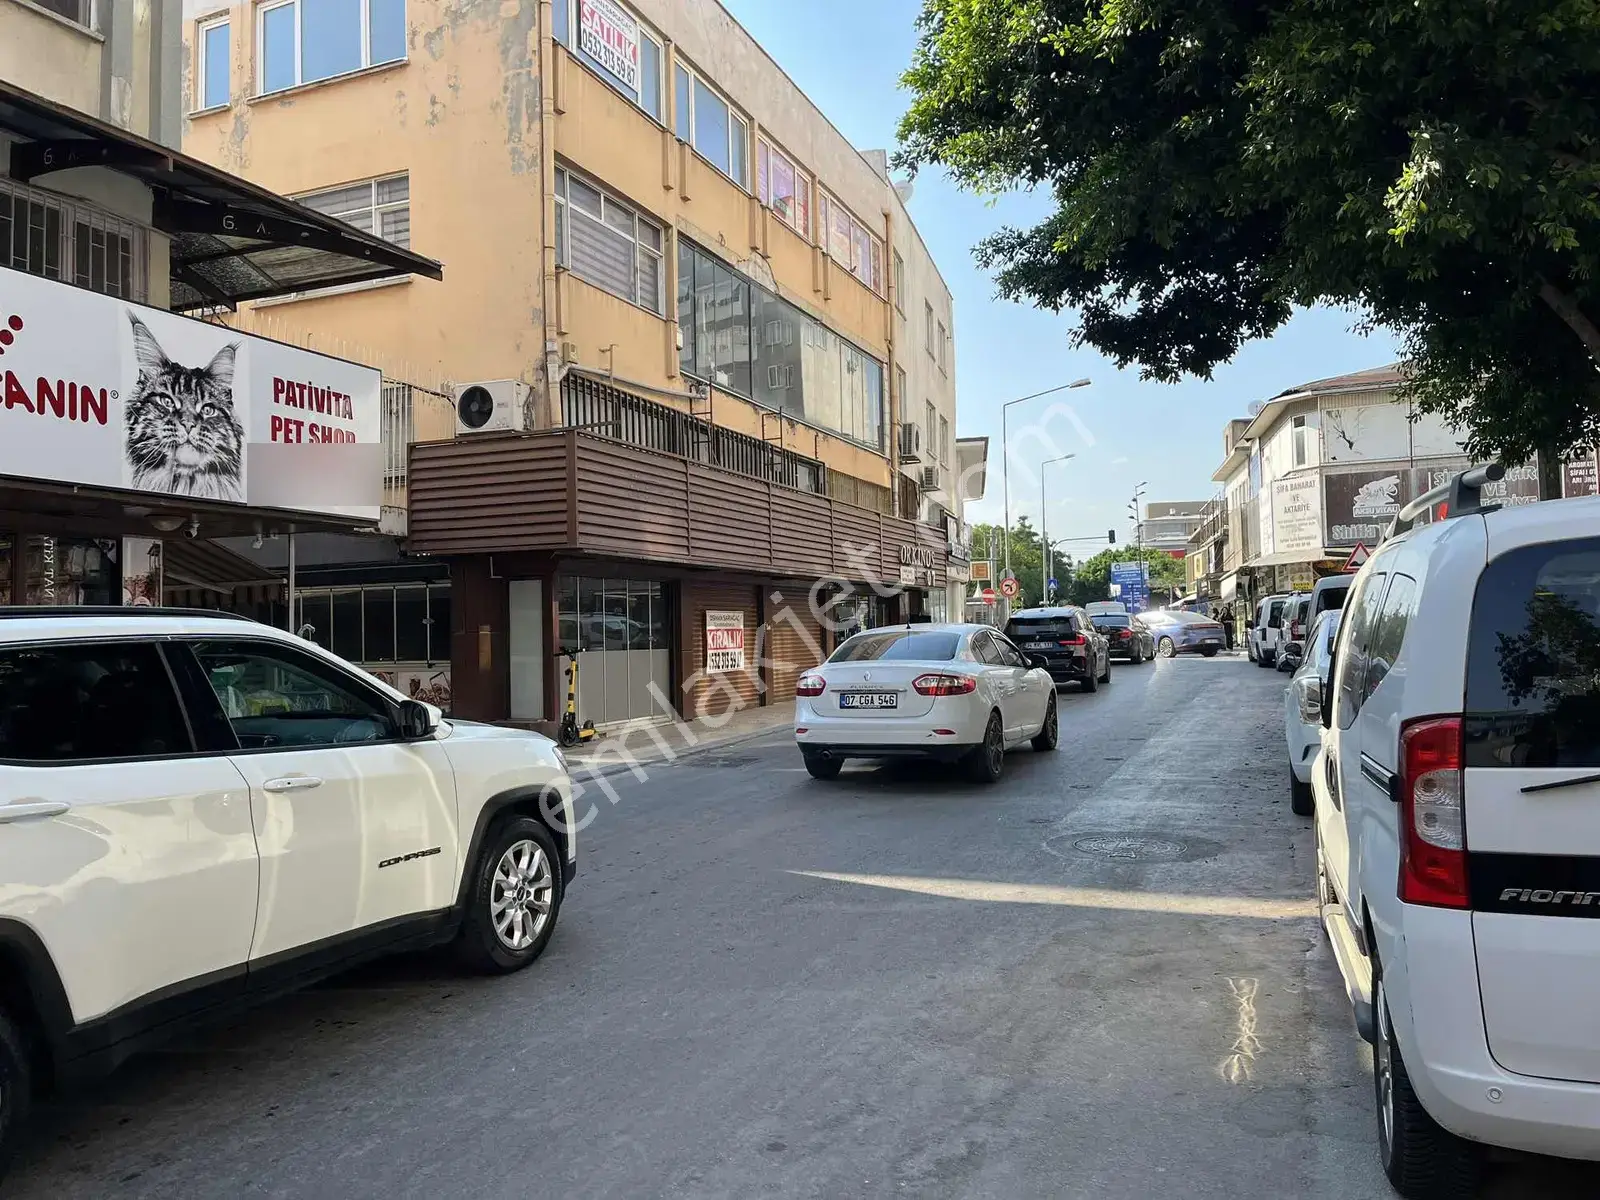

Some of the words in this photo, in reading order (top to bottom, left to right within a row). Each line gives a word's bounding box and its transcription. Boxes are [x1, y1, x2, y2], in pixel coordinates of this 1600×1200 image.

[582, 3, 636, 65] SATILIK
[583, 28, 602, 60] 0532
[603, 48, 615, 71] 313
[616, 56, 626, 78] 59
[0, 370, 108, 425] ANIN
[273, 376, 353, 420] PATİVİTA
[271, 415, 304, 444] PET
[309, 422, 356, 444] SHOP
[1293, 493, 1300, 502] VE
[1484, 482, 1507, 497] VE
[707, 629, 742, 649] KİRALIK
[845, 695, 856, 705] 07
[859, 695, 875, 705] CGA
[878, 695, 895, 705] 546
[378, 846, 442, 868] COMPASS
